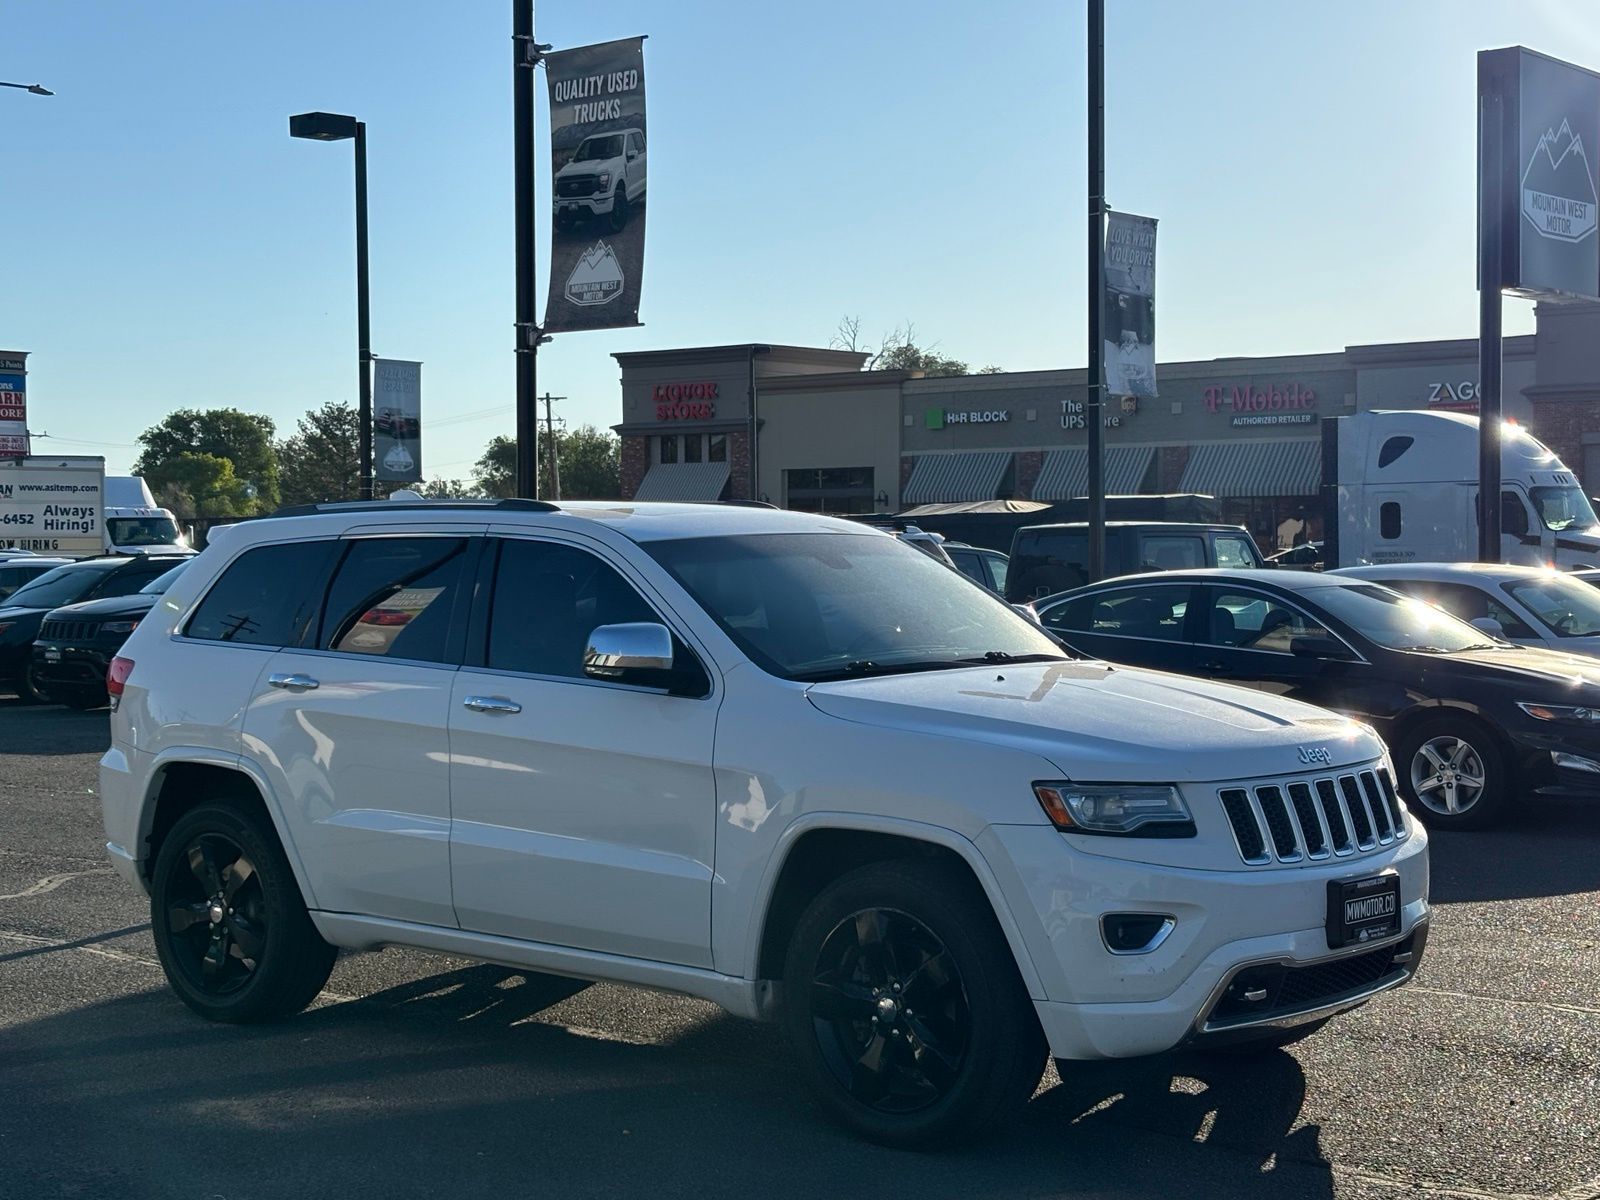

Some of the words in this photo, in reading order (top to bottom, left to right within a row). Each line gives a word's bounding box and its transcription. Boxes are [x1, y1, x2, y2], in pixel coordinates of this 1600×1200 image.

[554, 74, 604, 103] QUALITY
[607, 69, 638, 93] USED
[573, 99, 621, 125] TRUCKS
[1532, 192, 1566, 215] MOUNTAIN
[1567, 203, 1587, 220] WEST
[1546, 214, 1571, 234] MOTOR
[1111, 245, 1128, 262] YOU
[1129, 249, 1153, 267] DRIVE
[601, 280, 618, 291] WEST
[652, 382, 717, 402] LIQUOR
[1200, 383, 1316, 413] T-Mobile
[656, 401, 713, 420] STORE
[1061, 399, 1083, 413] The
[947, 413, 968, 424] H&R
[970, 410, 1009, 423] BLOCK
[1060, 415, 1086, 429] UPS
[1233, 416, 1278, 426] AUTHORIZED
[1279, 415, 1311, 424] RETAILER
[19, 484, 99, 493] www.asitemp.com
[43, 505, 95, 519] Always
[44, 519, 95, 534] Hiring!
[21, 540, 59, 551] HIRING
[1298, 746, 1332, 765] Jeep
[1346, 894, 1394, 921] MWMOTOR.CO
